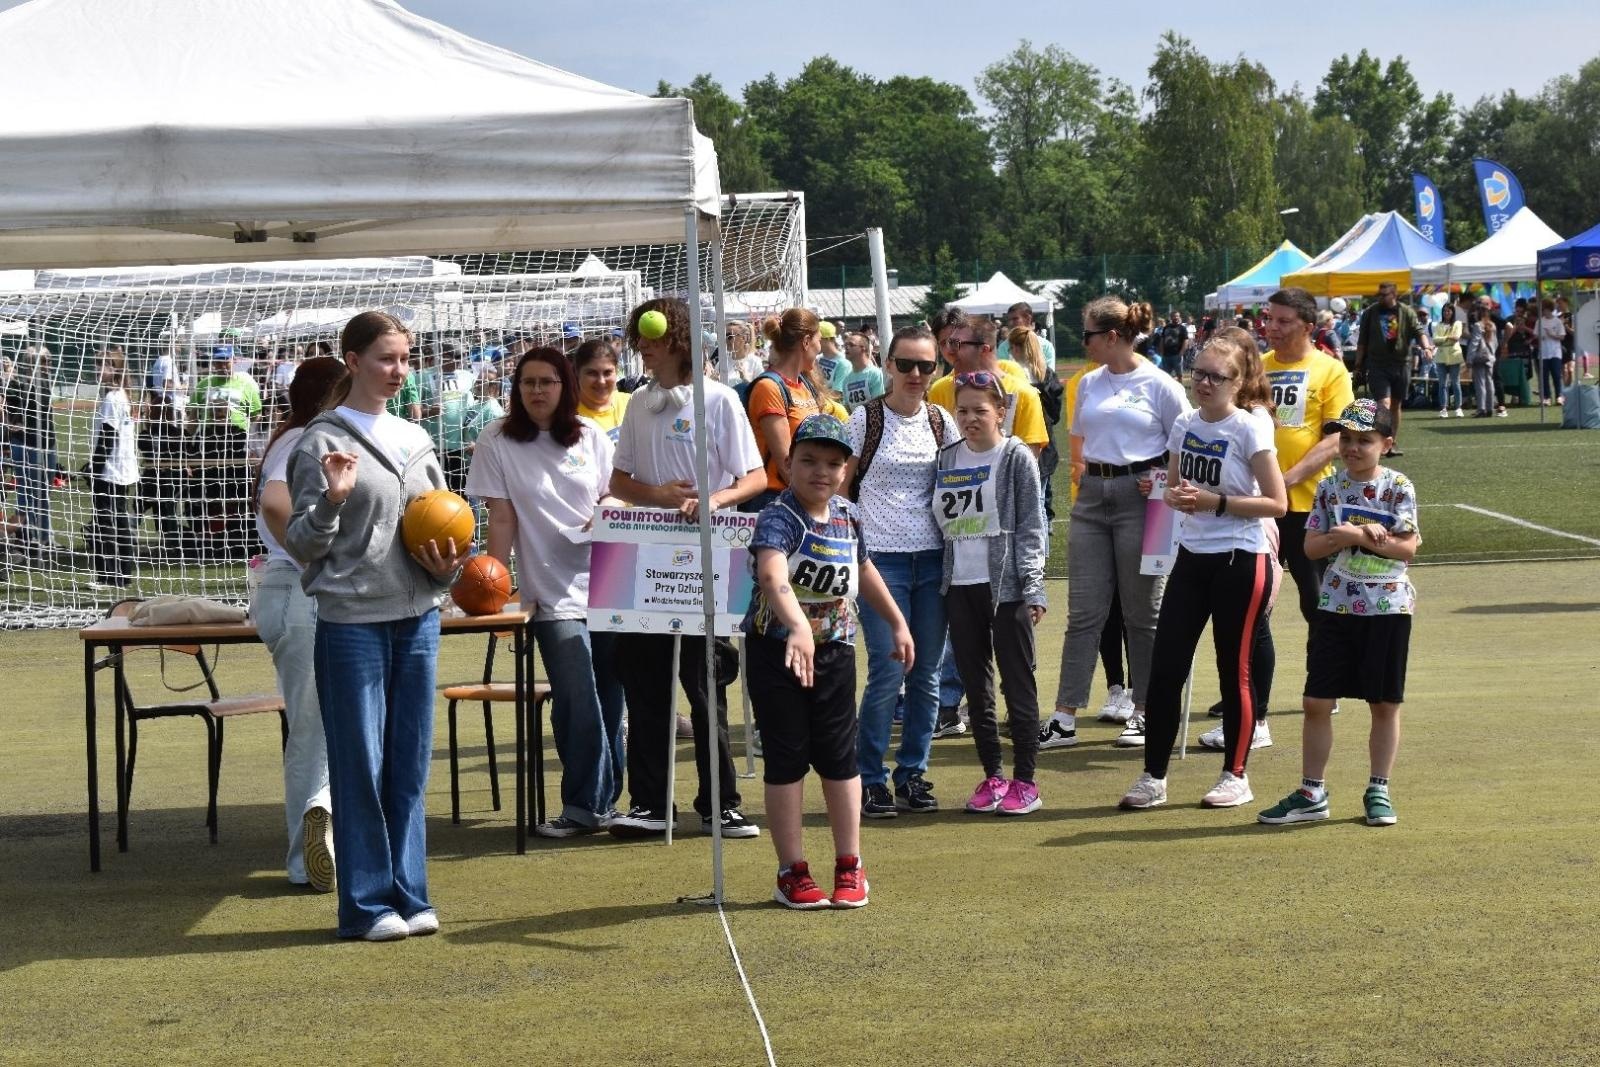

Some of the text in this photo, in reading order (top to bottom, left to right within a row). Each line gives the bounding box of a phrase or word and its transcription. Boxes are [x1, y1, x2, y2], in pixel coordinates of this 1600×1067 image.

[848, 389, 866, 403] 483
[941, 484, 984, 519] 271
[645, 568, 720, 581] Stowarzyszee
[792, 559, 850, 597] 603
[655, 582, 675, 594] Przy
